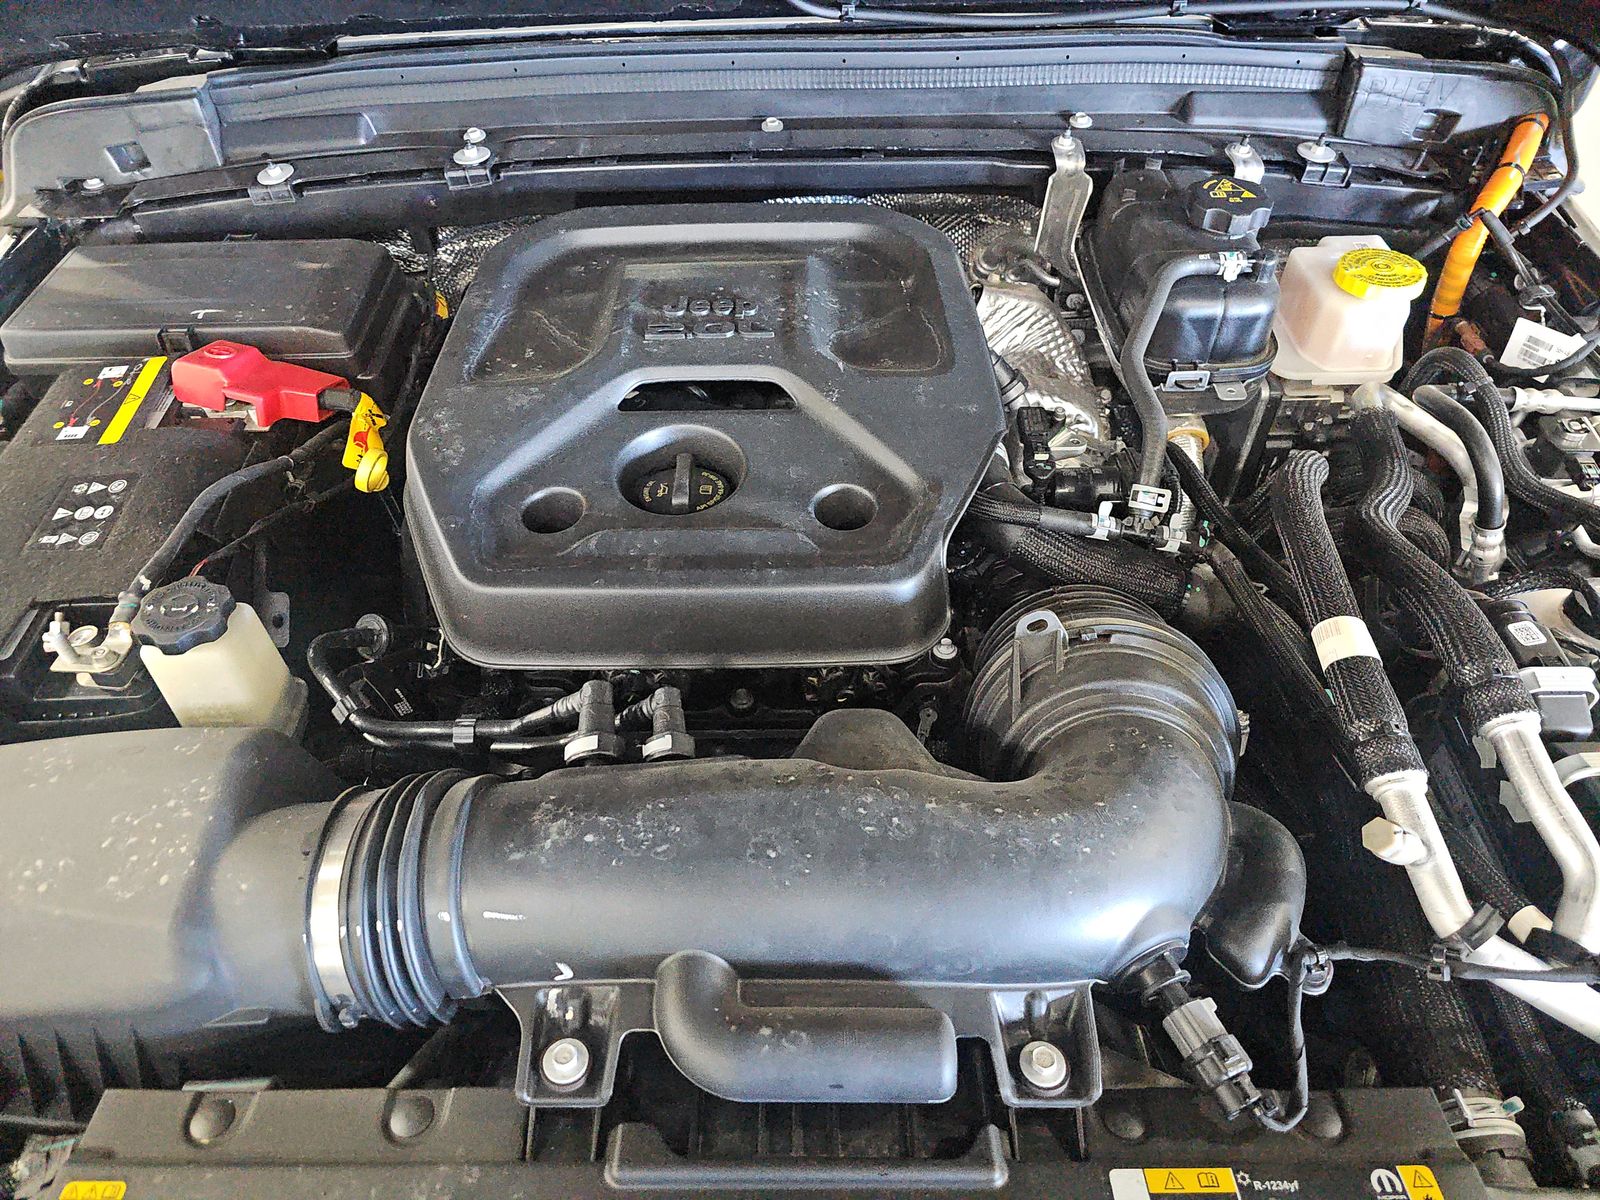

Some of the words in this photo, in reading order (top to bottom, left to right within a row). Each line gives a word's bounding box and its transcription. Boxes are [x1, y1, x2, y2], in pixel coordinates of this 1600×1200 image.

[663, 296, 759, 319] Jeep
[644, 320, 775, 341] 2.0L
[1253, 1180, 1299, 1193] R-1234yf
